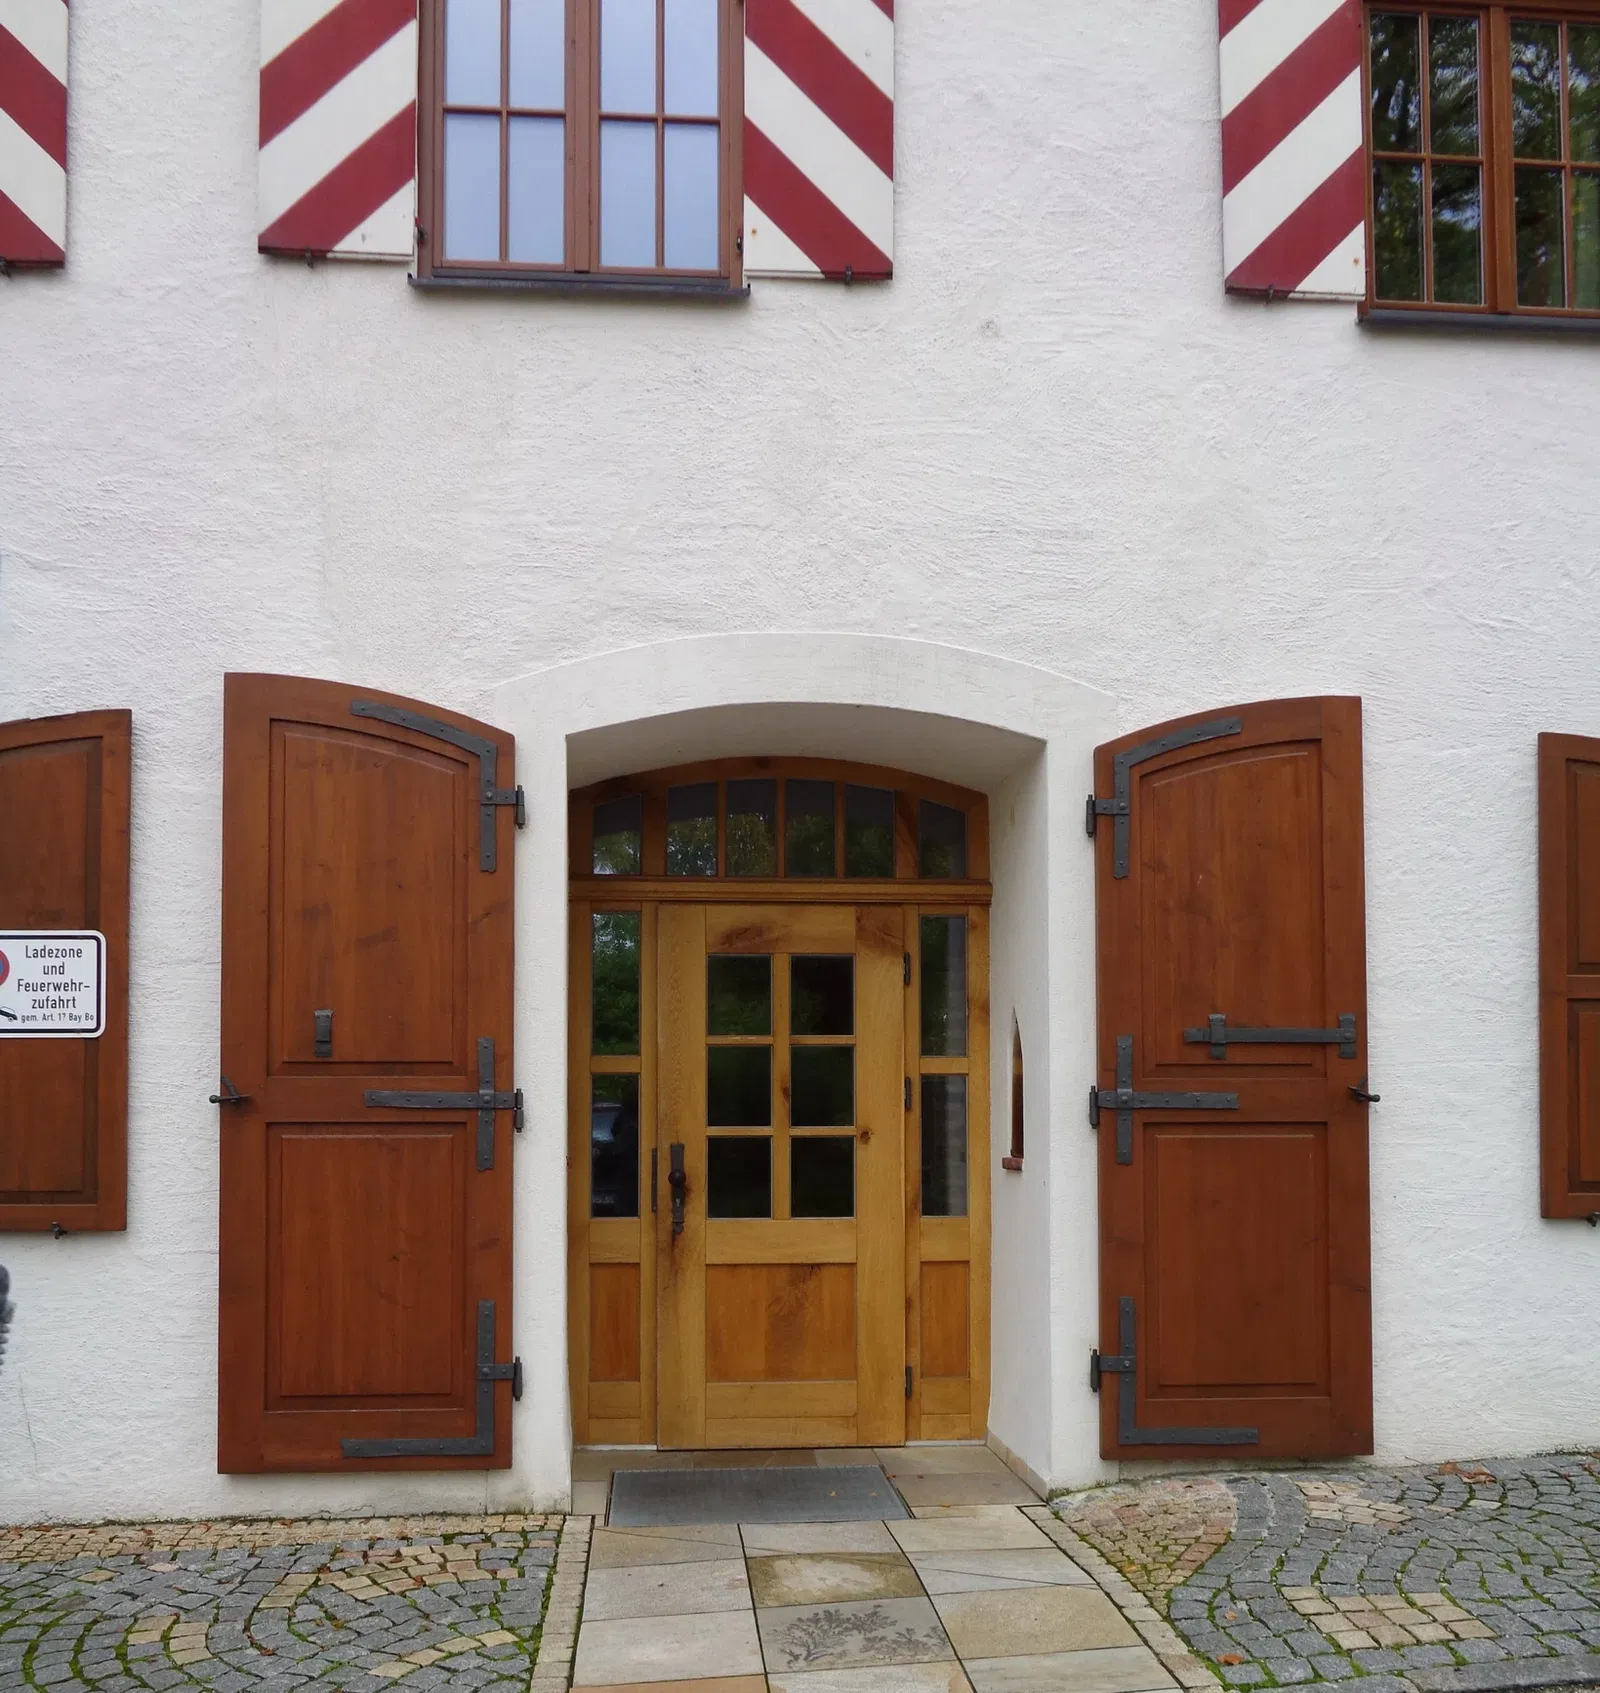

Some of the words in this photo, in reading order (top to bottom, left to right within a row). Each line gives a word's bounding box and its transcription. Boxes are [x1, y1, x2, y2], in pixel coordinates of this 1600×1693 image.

[25, 945, 82, 958] Ladezone
[43, 962, 65, 975] und
[17, 979, 90, 992] Feuerwehr-
[32, 996, 76, 1009] zufahrt
[21, 1014, 39, 1023] gem.
[42, 1013, 55, 1021] Art.
[58, 1013, 66, 1021] 17
[69, 1013, 82, 1023] Bay
